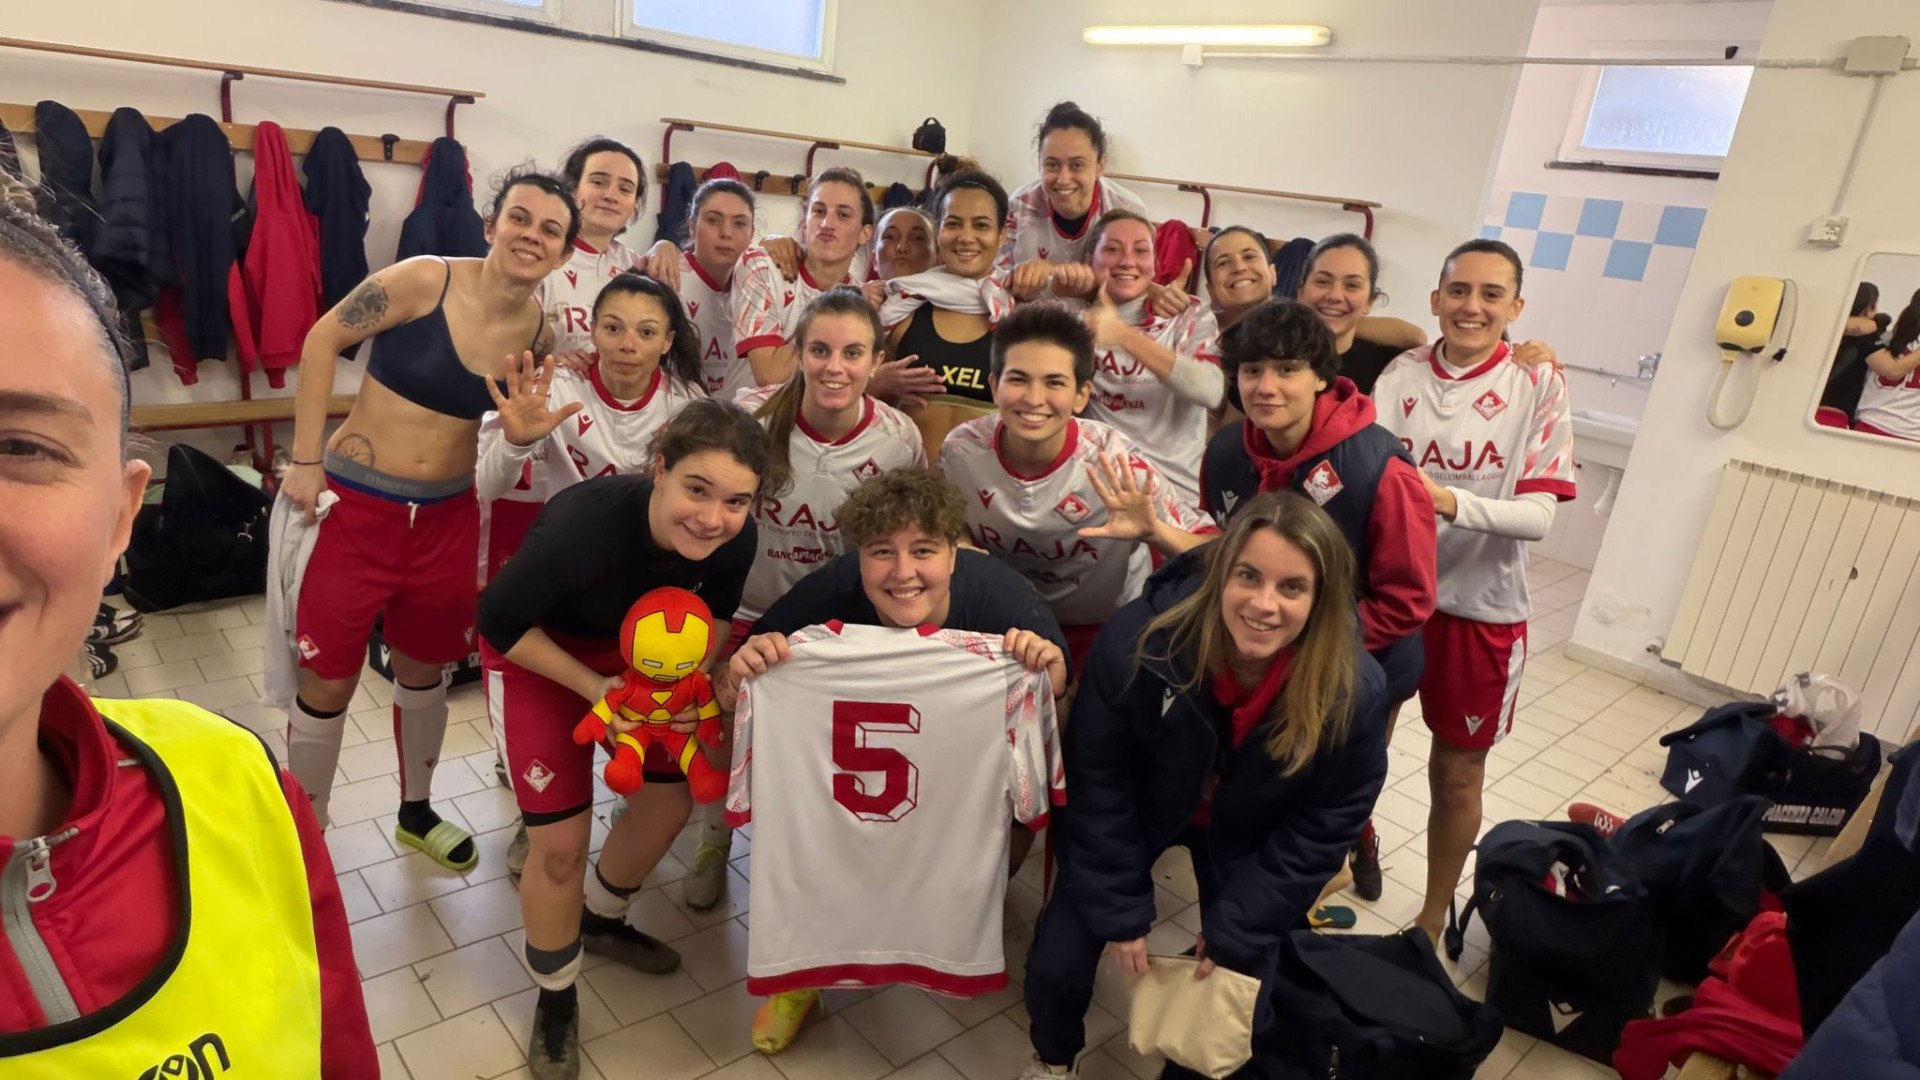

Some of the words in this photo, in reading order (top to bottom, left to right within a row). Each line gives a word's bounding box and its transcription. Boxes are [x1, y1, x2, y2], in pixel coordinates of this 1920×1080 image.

[925, 364, 985, 390] XEL
[1094, 349, 1148, 376] AJ
[755, 492, 841, 532] RAJ
[966, 522, 1099, 561] RAJA
[832, 700, 921, 822] 5
